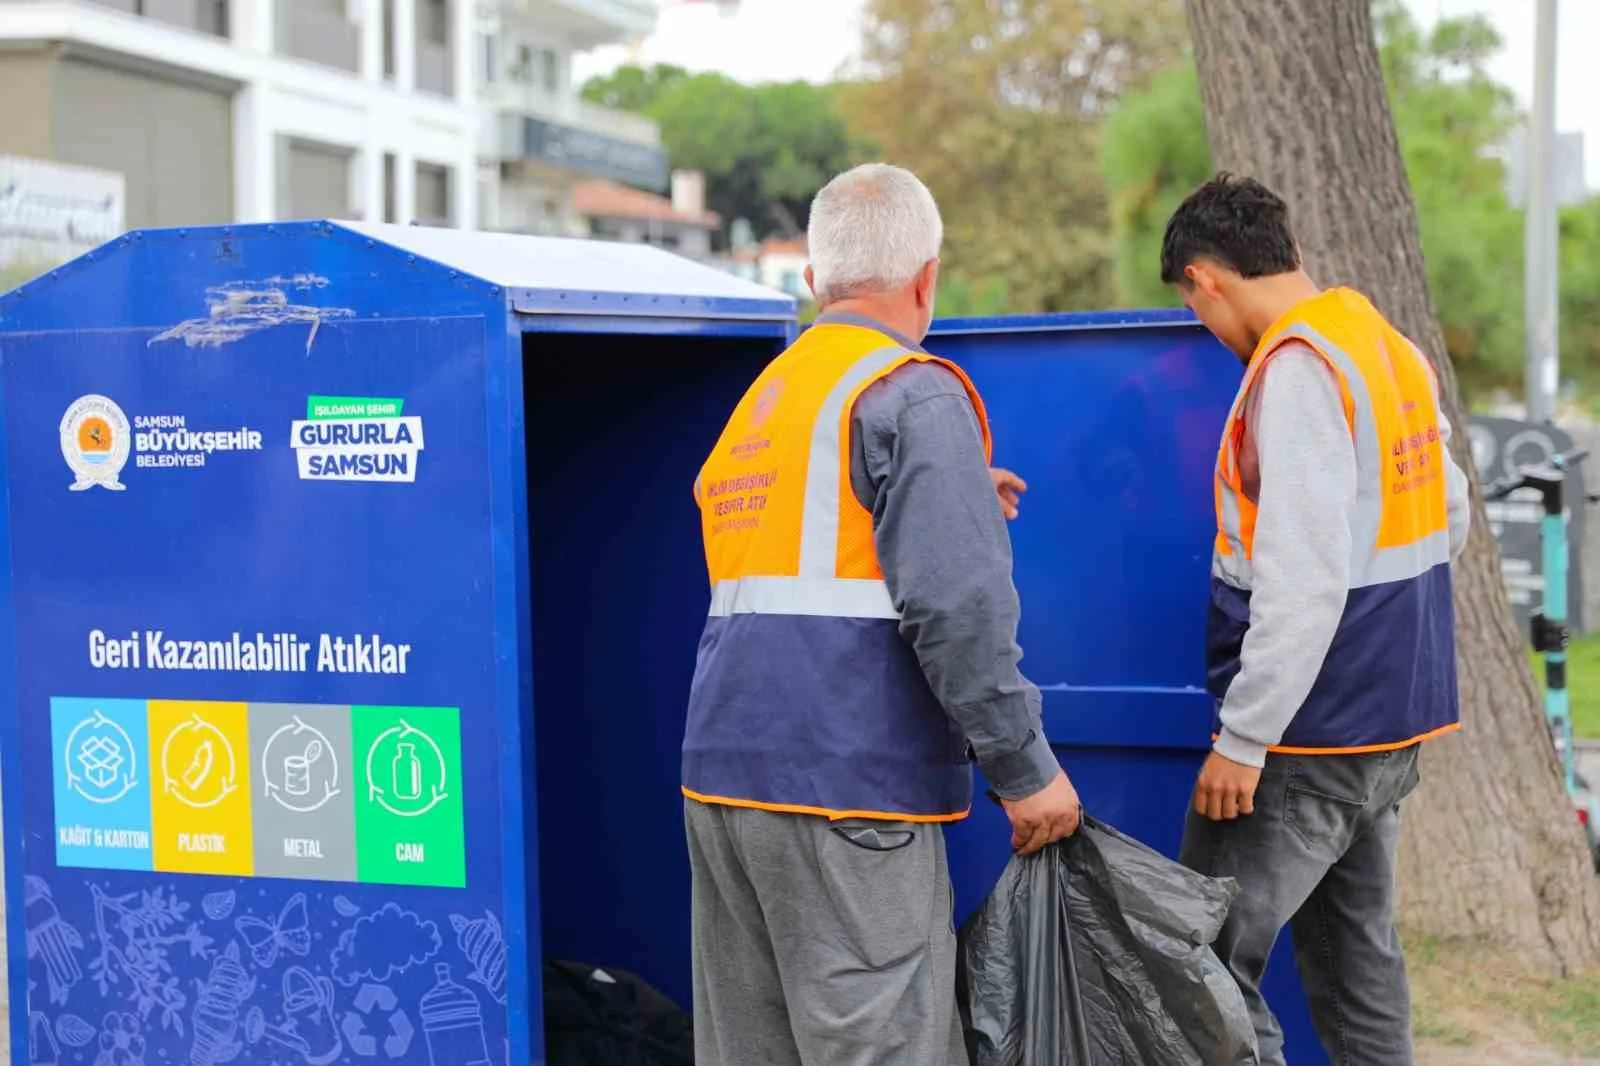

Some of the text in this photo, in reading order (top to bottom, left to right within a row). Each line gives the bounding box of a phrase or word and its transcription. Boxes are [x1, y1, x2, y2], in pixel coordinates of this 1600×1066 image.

[134, 416, 185, 428] SAMSUN
[135, 427, 263, 454] BÜYÜKŞEHİR
[299, 422, 414, 445] GURURLA
[136, 452, 205, 467] BELEDİYESİ
[308, 453, 408, 475] SAMSUN
[89, 629, 411, 674] Geri Kazanılabilir Atıklar
[104, 829, 150, 849] KARTON
[178, 832, 226, 853] PLASTİK
[284, 838, 325, 858] METAL
[395, 842, 425, 862] CAM
